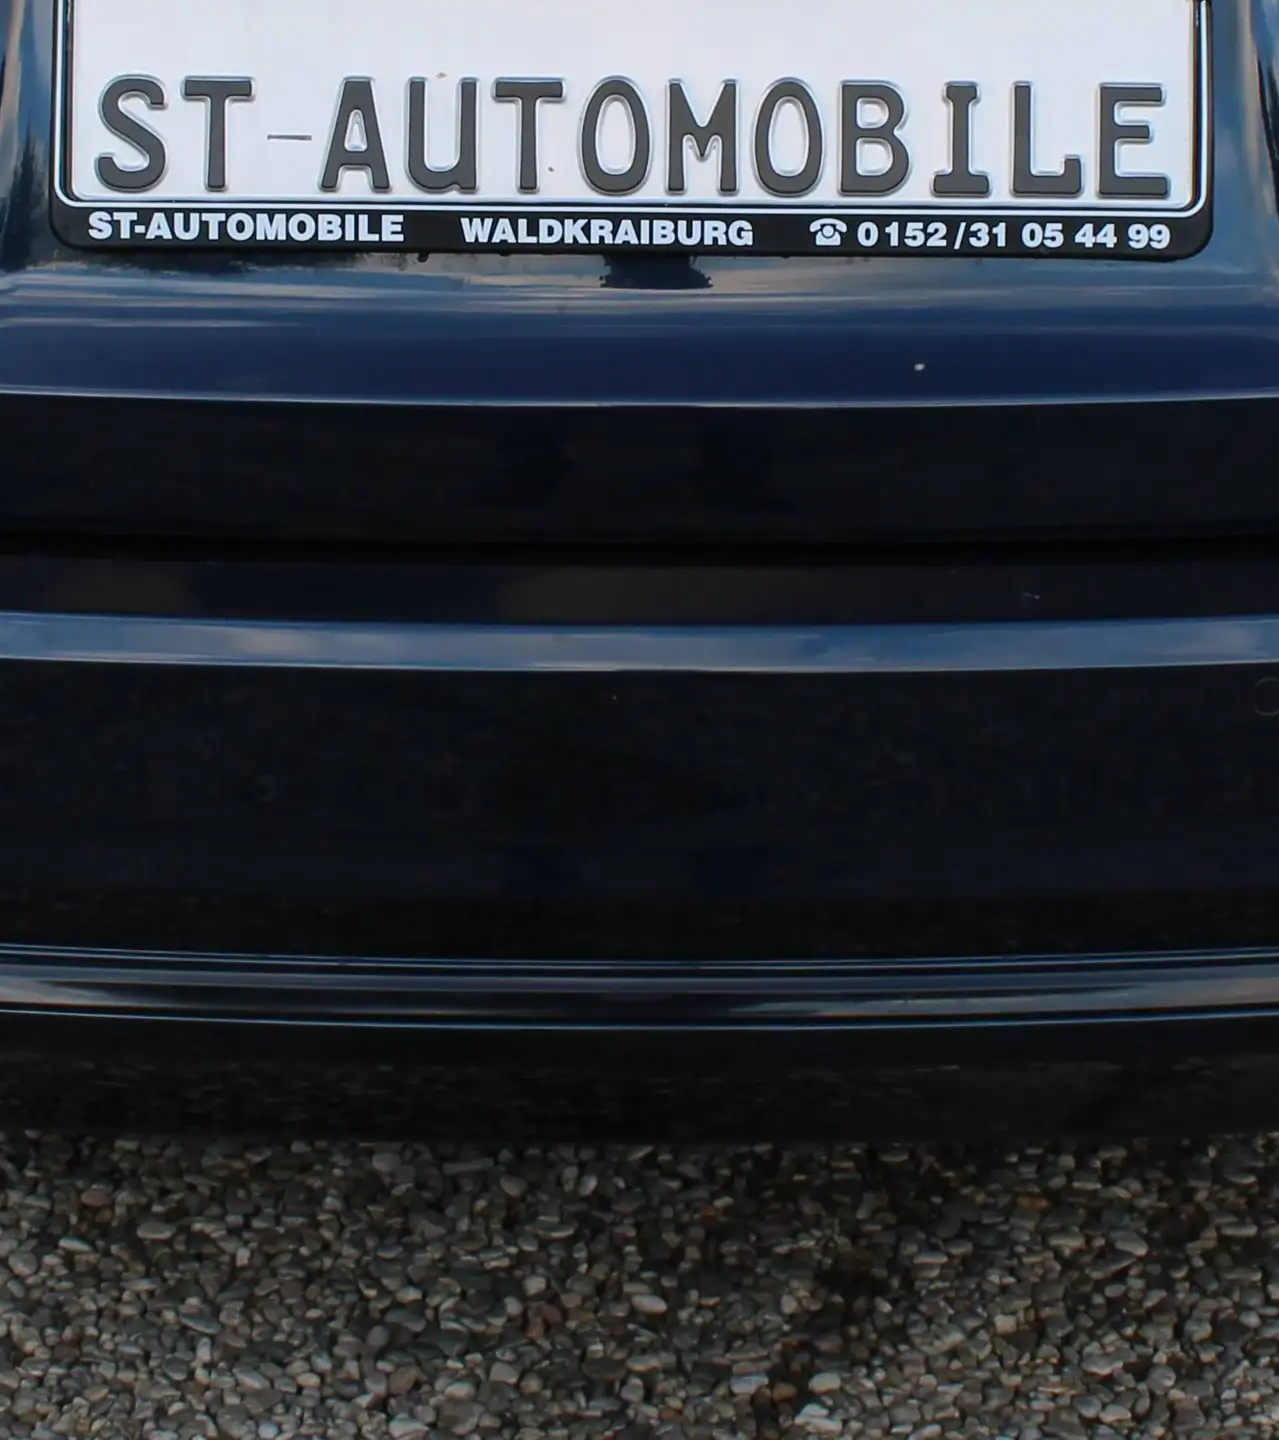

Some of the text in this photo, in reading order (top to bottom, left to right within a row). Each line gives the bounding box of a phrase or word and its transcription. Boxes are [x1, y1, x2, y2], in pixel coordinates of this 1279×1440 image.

[88, 211, 405, 242] ST-AUTOMOBILE
[460, 217, 754, 246] WALDKRAIBURG
[1021, 221, 1064, 248] 05
[1073, 222, 1118, 248] 44
[1127, 223, 1171, 249] 99
